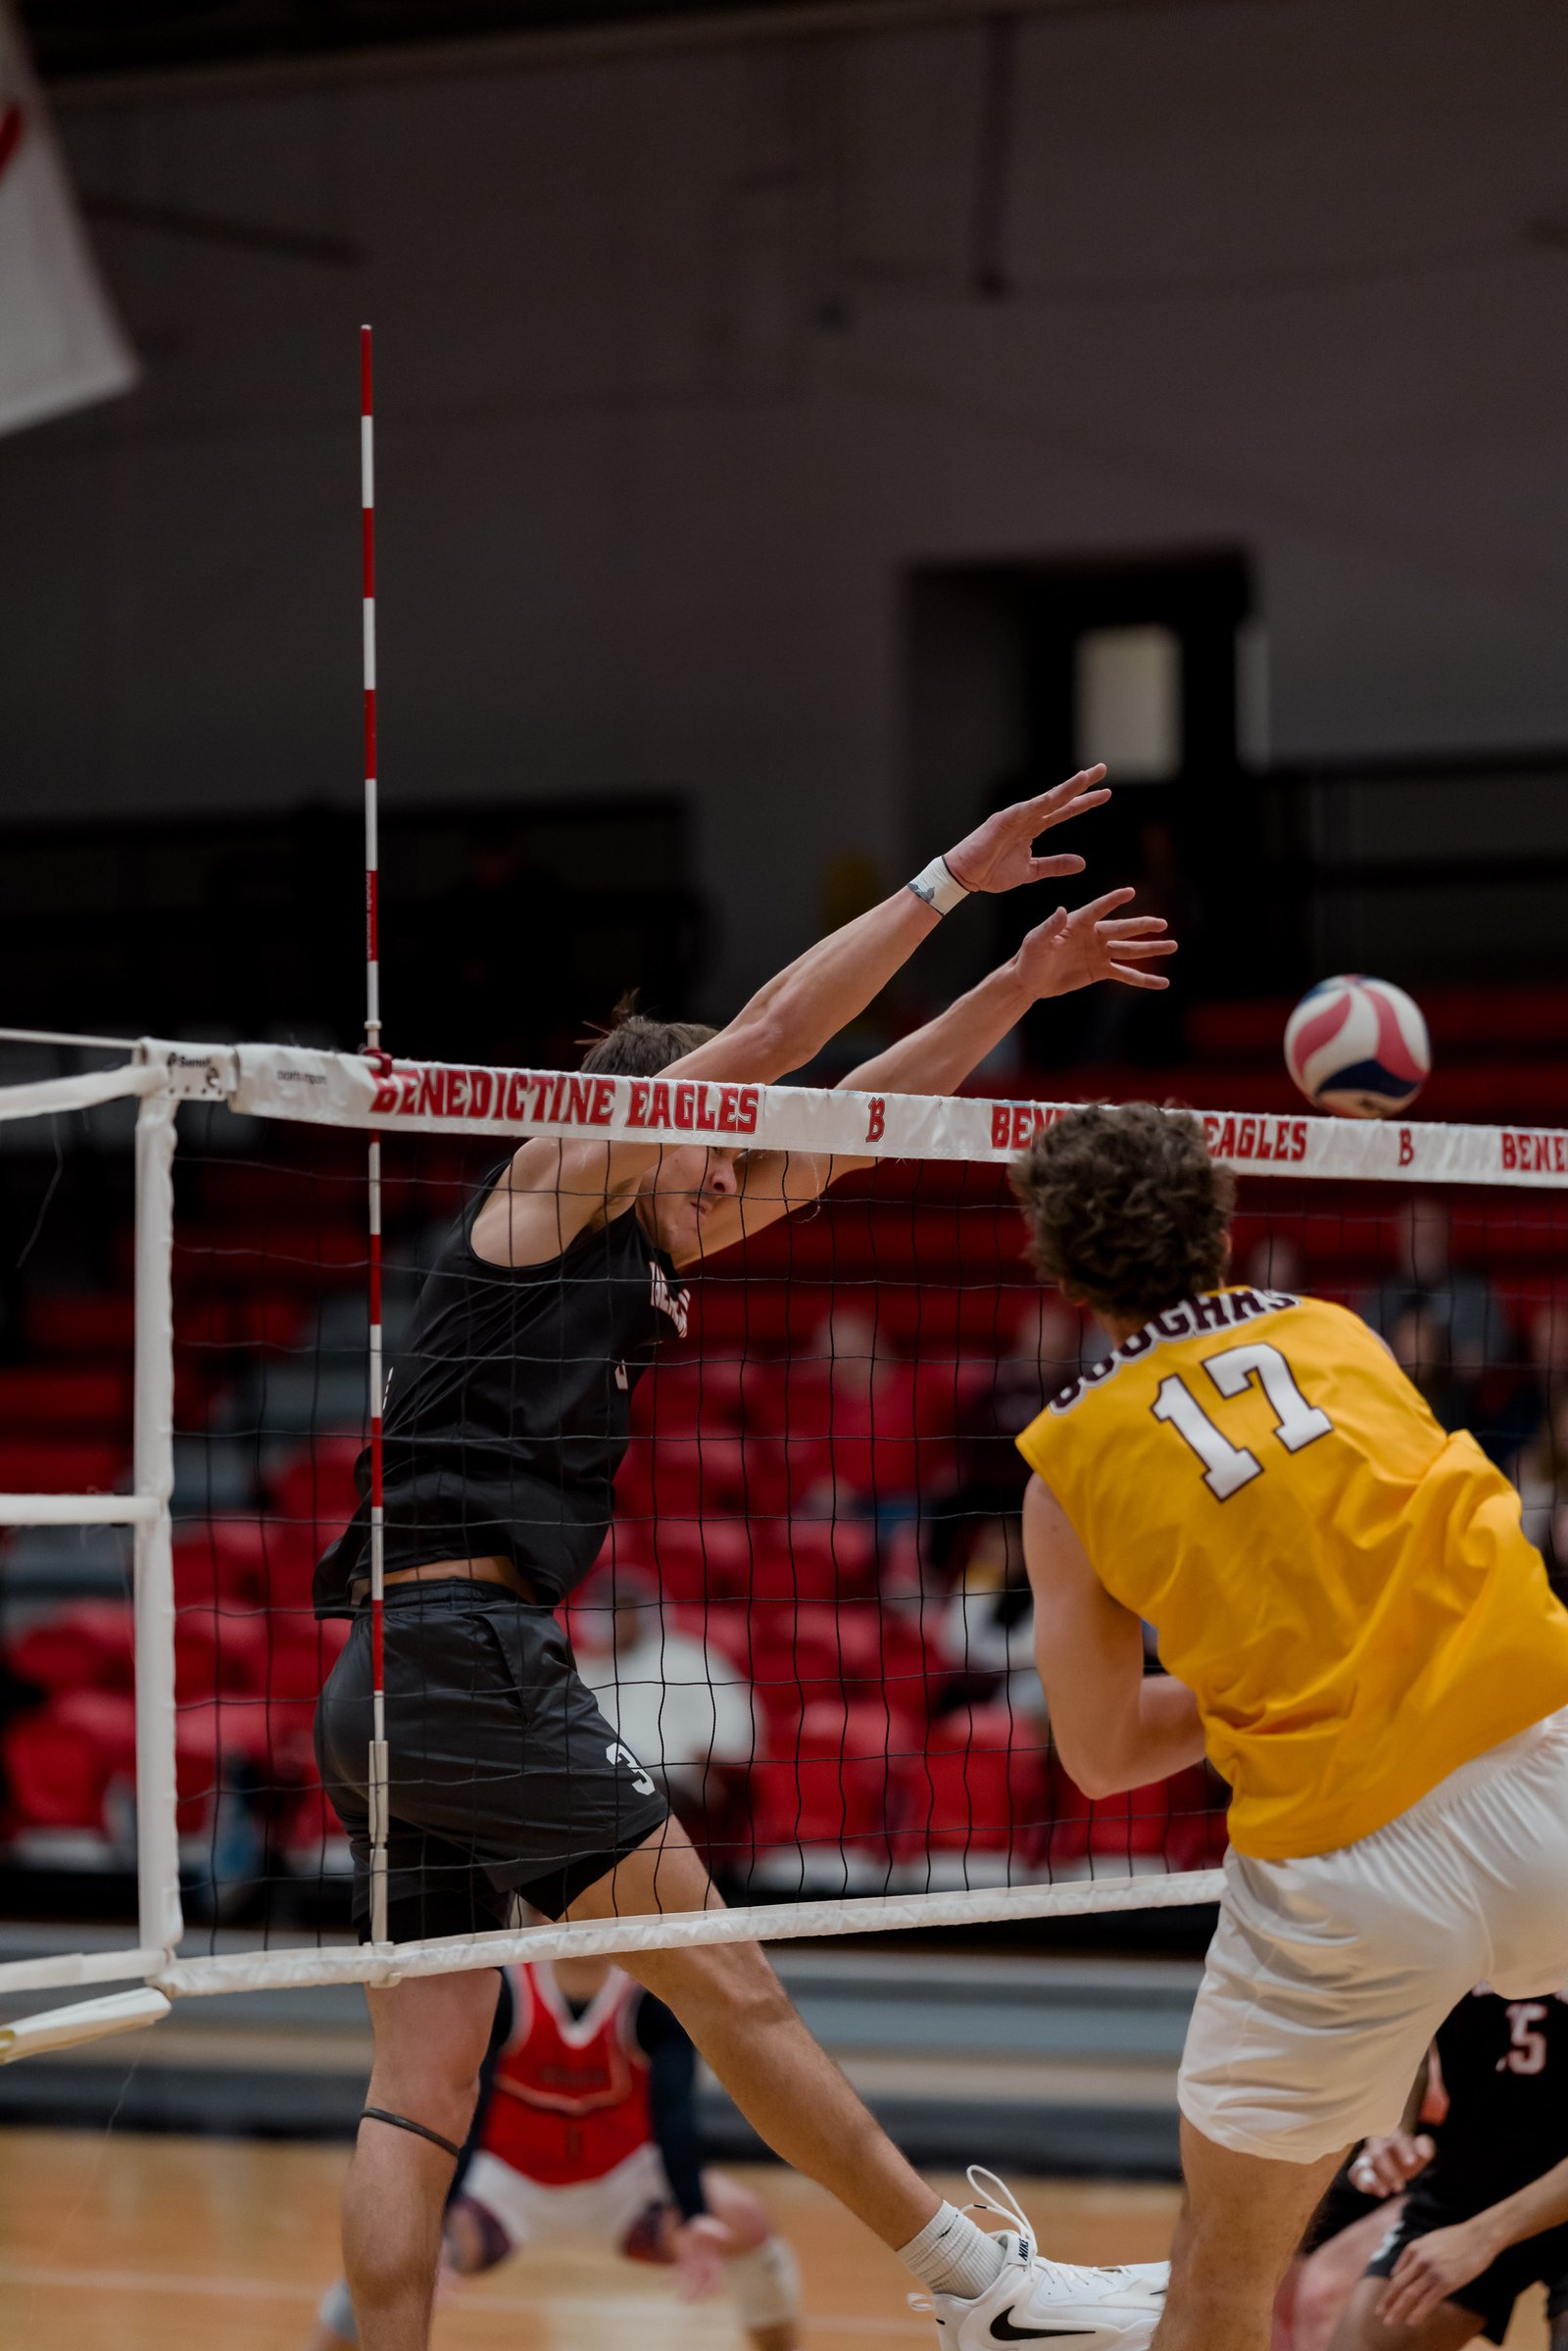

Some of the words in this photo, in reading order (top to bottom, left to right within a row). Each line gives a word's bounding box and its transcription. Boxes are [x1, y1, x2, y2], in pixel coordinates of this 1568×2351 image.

[370, 1068, 615, 1126] BENEDICTINE
[624, 1082, 760, 1135] EAGLES
[865, 1097, 886, 1143] B
[1202, 1116, 1307, 1161] EAGLES
[1397, 1128, 1414, 1166] B
[1150, 1342, 1334, 1503] 17
[605, 1741, 656, 1795] 3
[1018, 2237, 1029, 2262] NIKE
